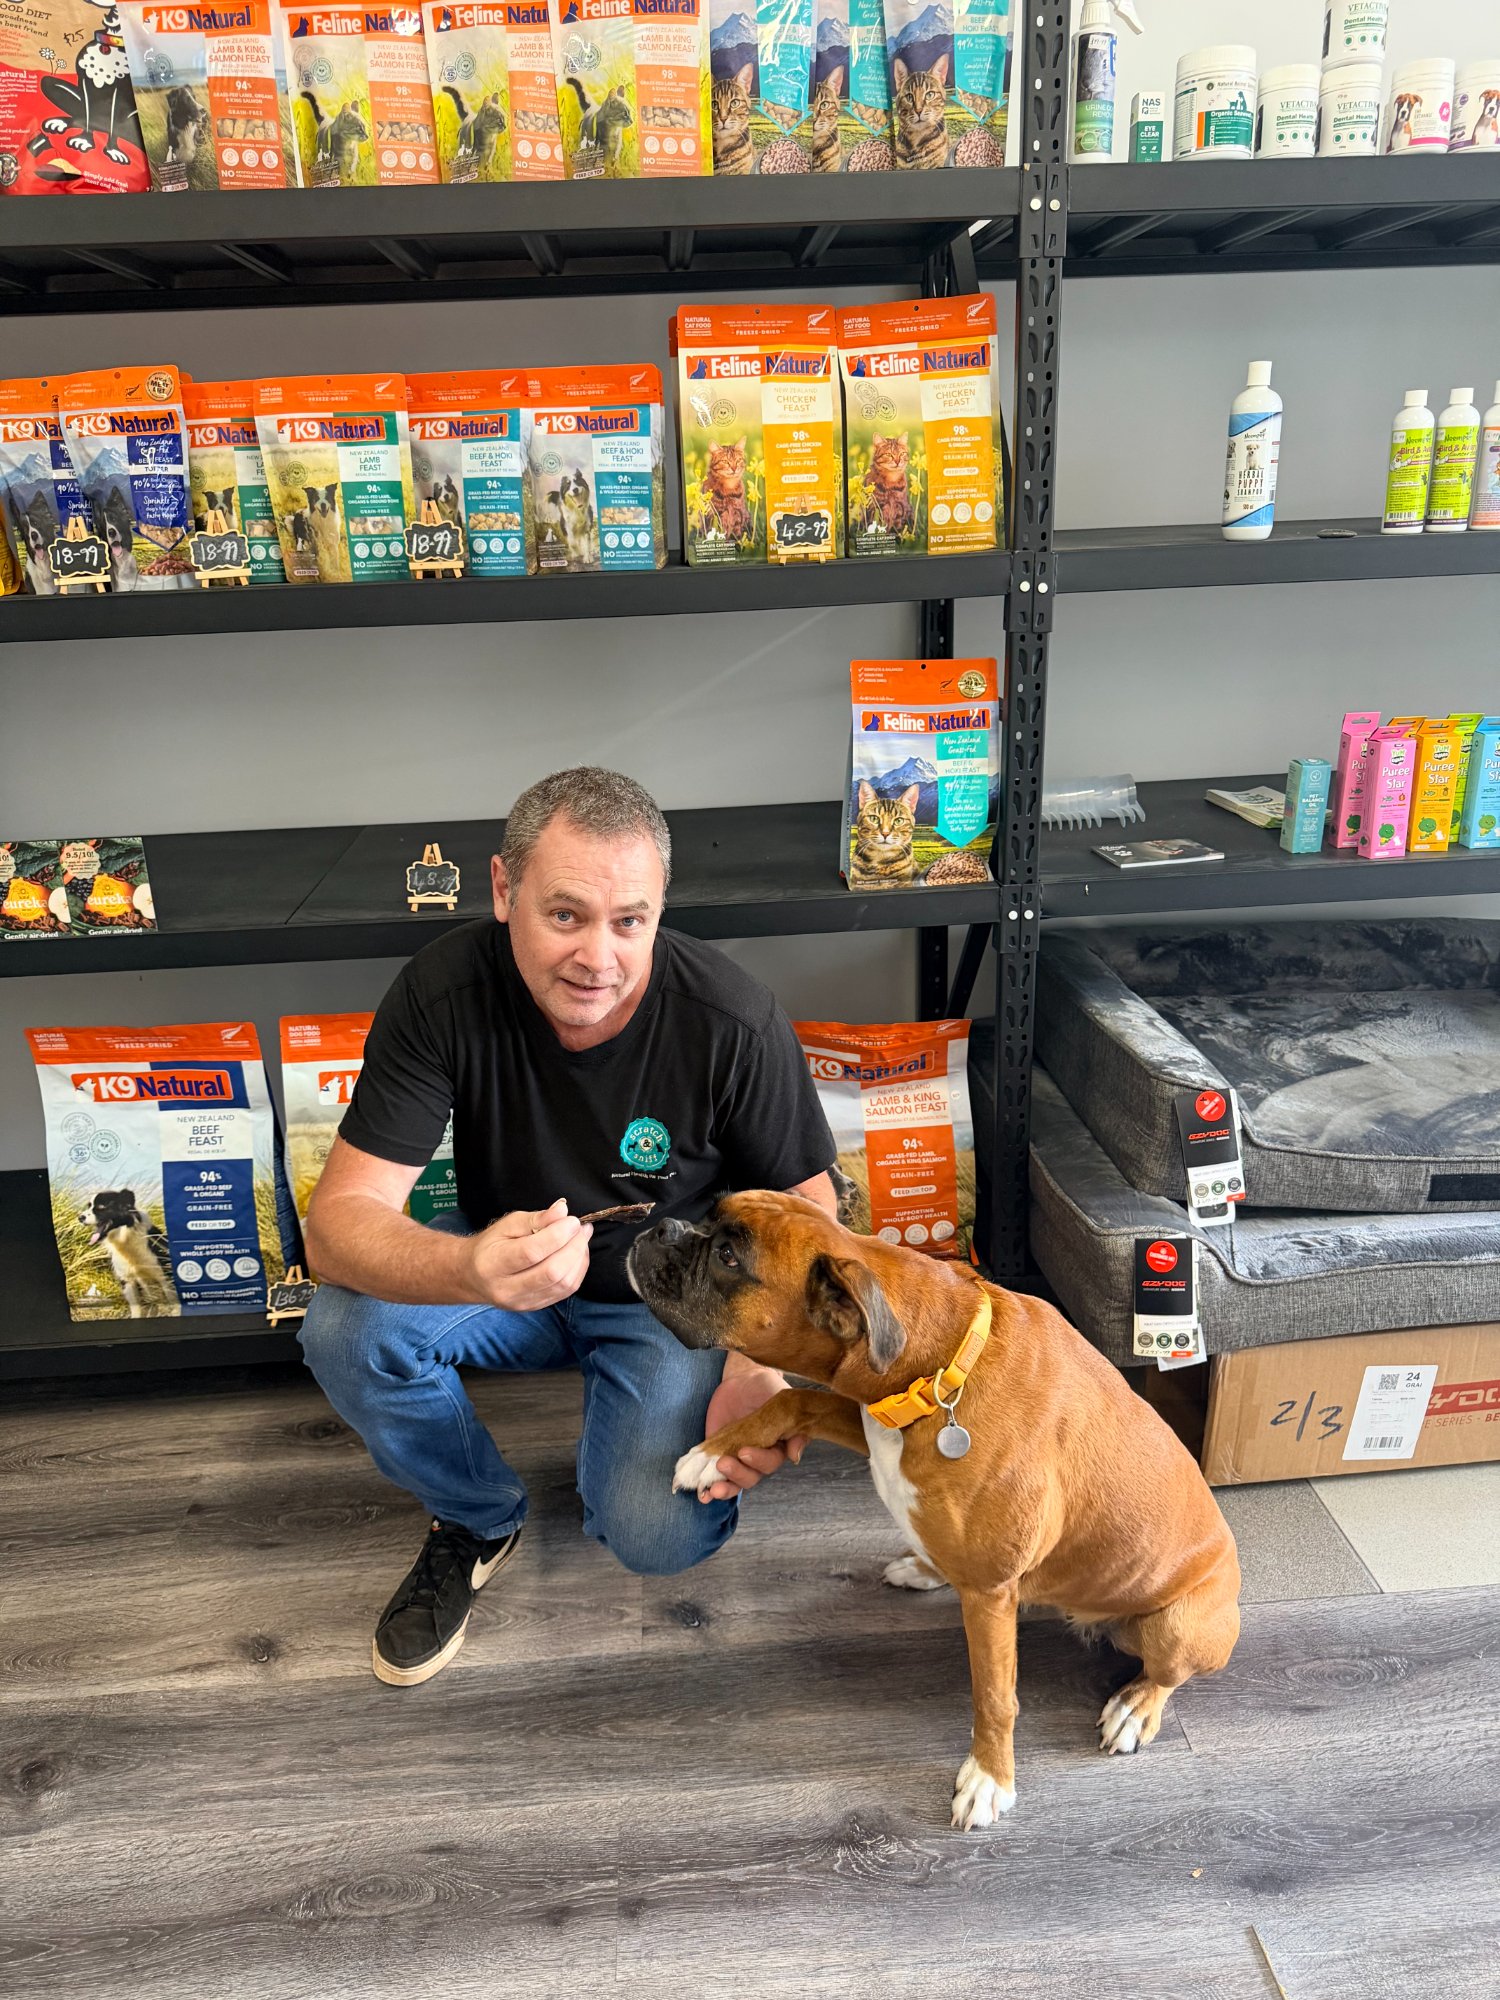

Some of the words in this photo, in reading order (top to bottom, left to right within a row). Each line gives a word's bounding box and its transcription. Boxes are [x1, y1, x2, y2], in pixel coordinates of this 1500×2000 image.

[26, 8, 52, 20] DIET
[582, 0, 631, 18] Feline
[634, 0, 696, 14] Natural
[312, 13, 362, 34] Feline
[1344, 16, 1366, 25] Dental
[4, 21, 22, 30] best
[23, 25, 48, 38] friend
[212, 46, 235, 54] LAMB
[244, 46, 266, 54] KING
[638, 44, 672, 52] SALMON
[673, 44, 696, 53] FEAST
[208, 54, 244, 62] SALMON
[245, 54, 271, 64] FEAST
[510, 51, 544, 59] SALMON
[1334, 114, 1355, 123] Dental
[221, 170, 234, 178] NO
[843, 316, 870, 324] NATURAL
[894, 324, 940, 333] FREEZE-DRIED
[711, 356, 761, 378] Feline
[766, 354, 827, 376] Natural
[870, 353, 920, 376] Feline
[923, 345, 986, 370] Natural
[776, 396, 816, 404] CHICKEN
[936, 389, 976, 400] CHICKEN
[943, 398, 970, 408] FEAST
[425, 416, 504, 438] K9Natural
[552, 412, 635, 432] K9Natural
[294, 417, 380, 440] K9Natural
[136, 439, 148, 447] New
[150, 438, 174, 449] Zealand
[1238, 470, 1264, 478] HERBAL
[133, 478, 150, 490] 90%
[1238, 479, 1264, 488] PUPPY
[782, 522, 828, 540] 48-99
[412, 530, 452, 556] 18-99
[930, 535, 944, 544] NO
[56, 544, 98, 567] 18-99
[200, 540, 238, 562] 18-99
[884, 714, 926, 732] Feline
[928, 710, 986, 731] Natural
[943, 737, 956, 745] New
[958, 736, 981, 744] Zealand
[948, 745, 976, 754] Grass-Fed
[1382, 766, 1410, 777] Puree
[1424, 762, 1455, 772] Puree
[1386, 779, 1406, 788] Star
[1428, 774, 1450, 784] Star
[66, 851, 94, 859] 9.5/10!
[2, 896, 48, 910] eureka
[86, 893, 133, 906] eureka
[29, 931, 59, 939] air-dried
[809, 1054, 926, 1081] K9Natural
[100, 1075, 225, 1100] K9Natural
[896, 1084, 932, 1092] ZEALAND
[870, 1096, 900, 1107] LAMB
[902, 1096, 911, 1104] &
[914, 1092, 941, 1102] KING
[866, 1106, 912, 1118] SALMON
[914, 1102, 948, 1113] FEAST
[192, 1125, 220, 1136] BEEF
[630, 1126, 664, 1142] scratch
[189, 1136, 224, 1146] FEAST
[642, 1140, 650, 1148] &
[902, 1138, 924, 1150] 94%
[634, 1153, 658, 1163] sniff
[200, 1171, 222, 1183] 94%
[890, 1170, 934, 1179] GRAIN-FREE
[186, 1204, 233, 1212] GRAIN-FREE
[896, 1208, 934, 1216] SUPPORTING
[882, 1214, 924, 1224] WHOLE-BODY
[924, 1211, 948, 1219] HEALTH
[1406, 1372, 1421, 1381] 24
[1270, 1390, 1344, 1442] 2/3
[1434, 1416, 1473, 1428] SERIES
